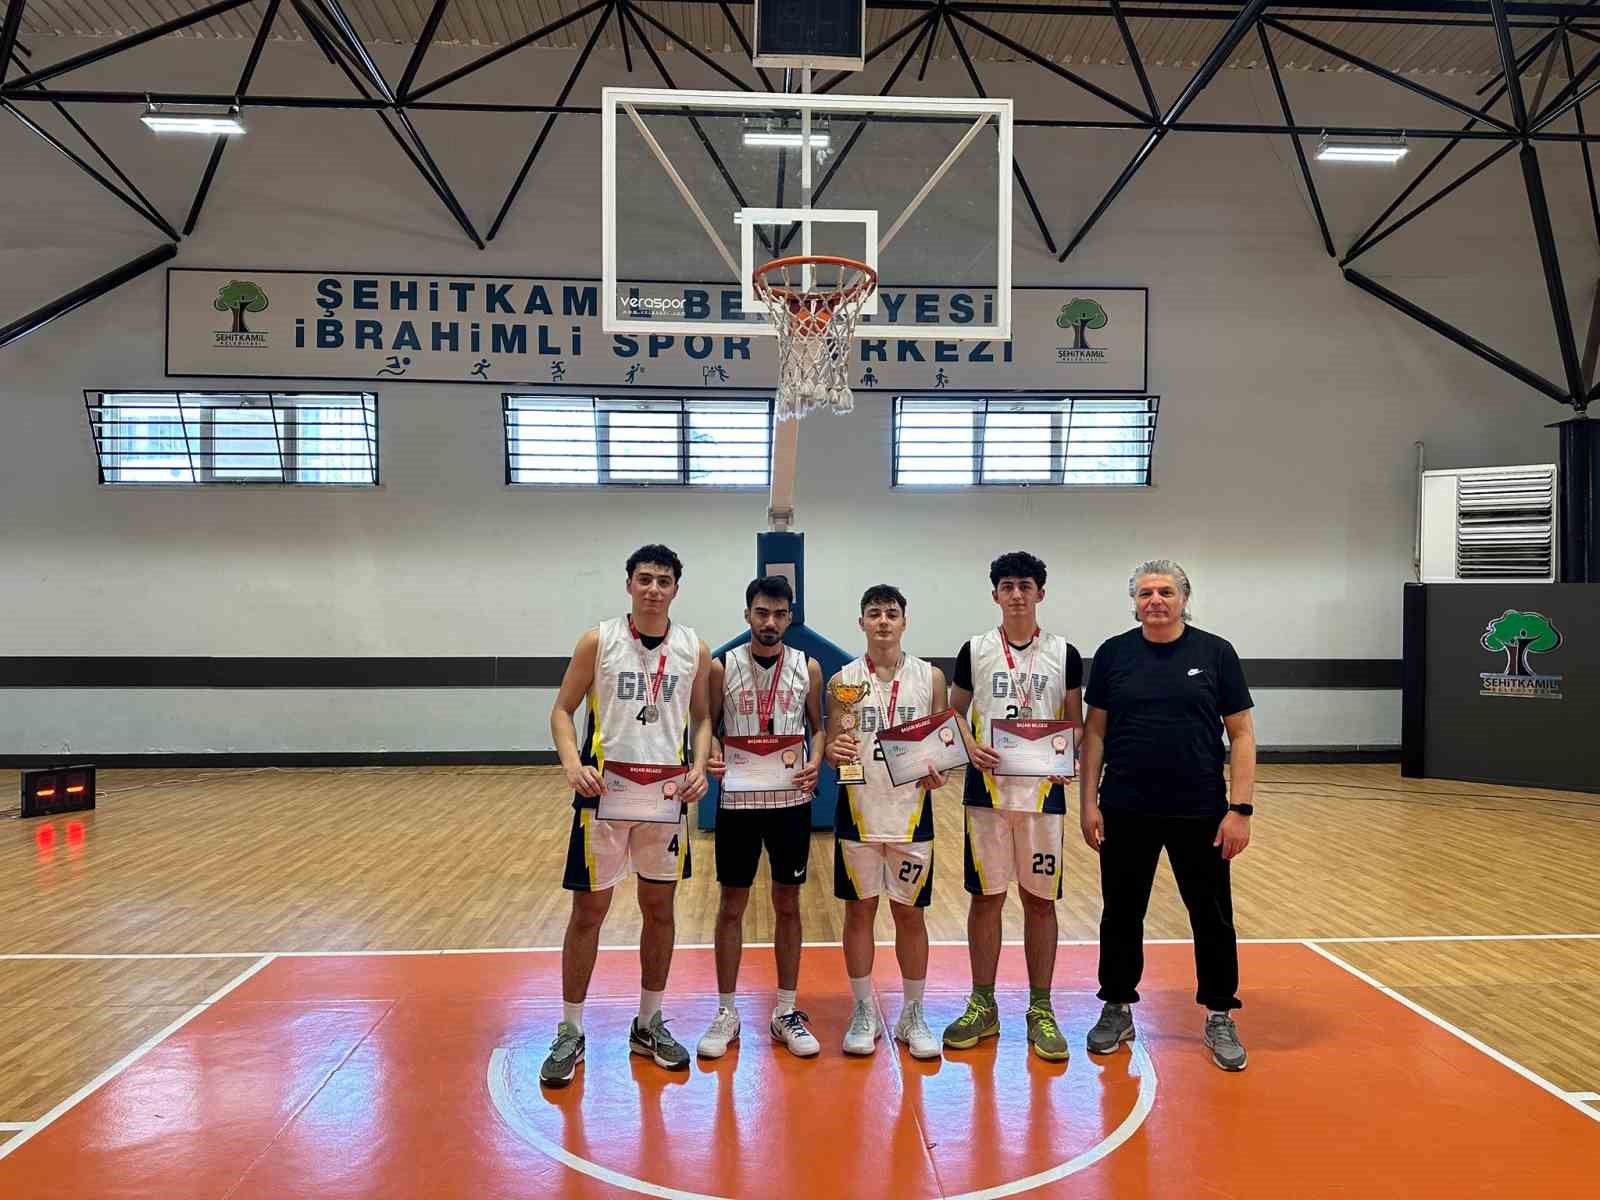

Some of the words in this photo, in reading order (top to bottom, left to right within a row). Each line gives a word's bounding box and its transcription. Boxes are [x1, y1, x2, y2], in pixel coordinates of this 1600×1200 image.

[620, 296, 687, 312] veraspor
[612, 333, 752, 361] SPOR
[668, 834, 679, 856] 4
[899, 861, 923, 884] 27
[1032, 853, 1055, 876] 23
